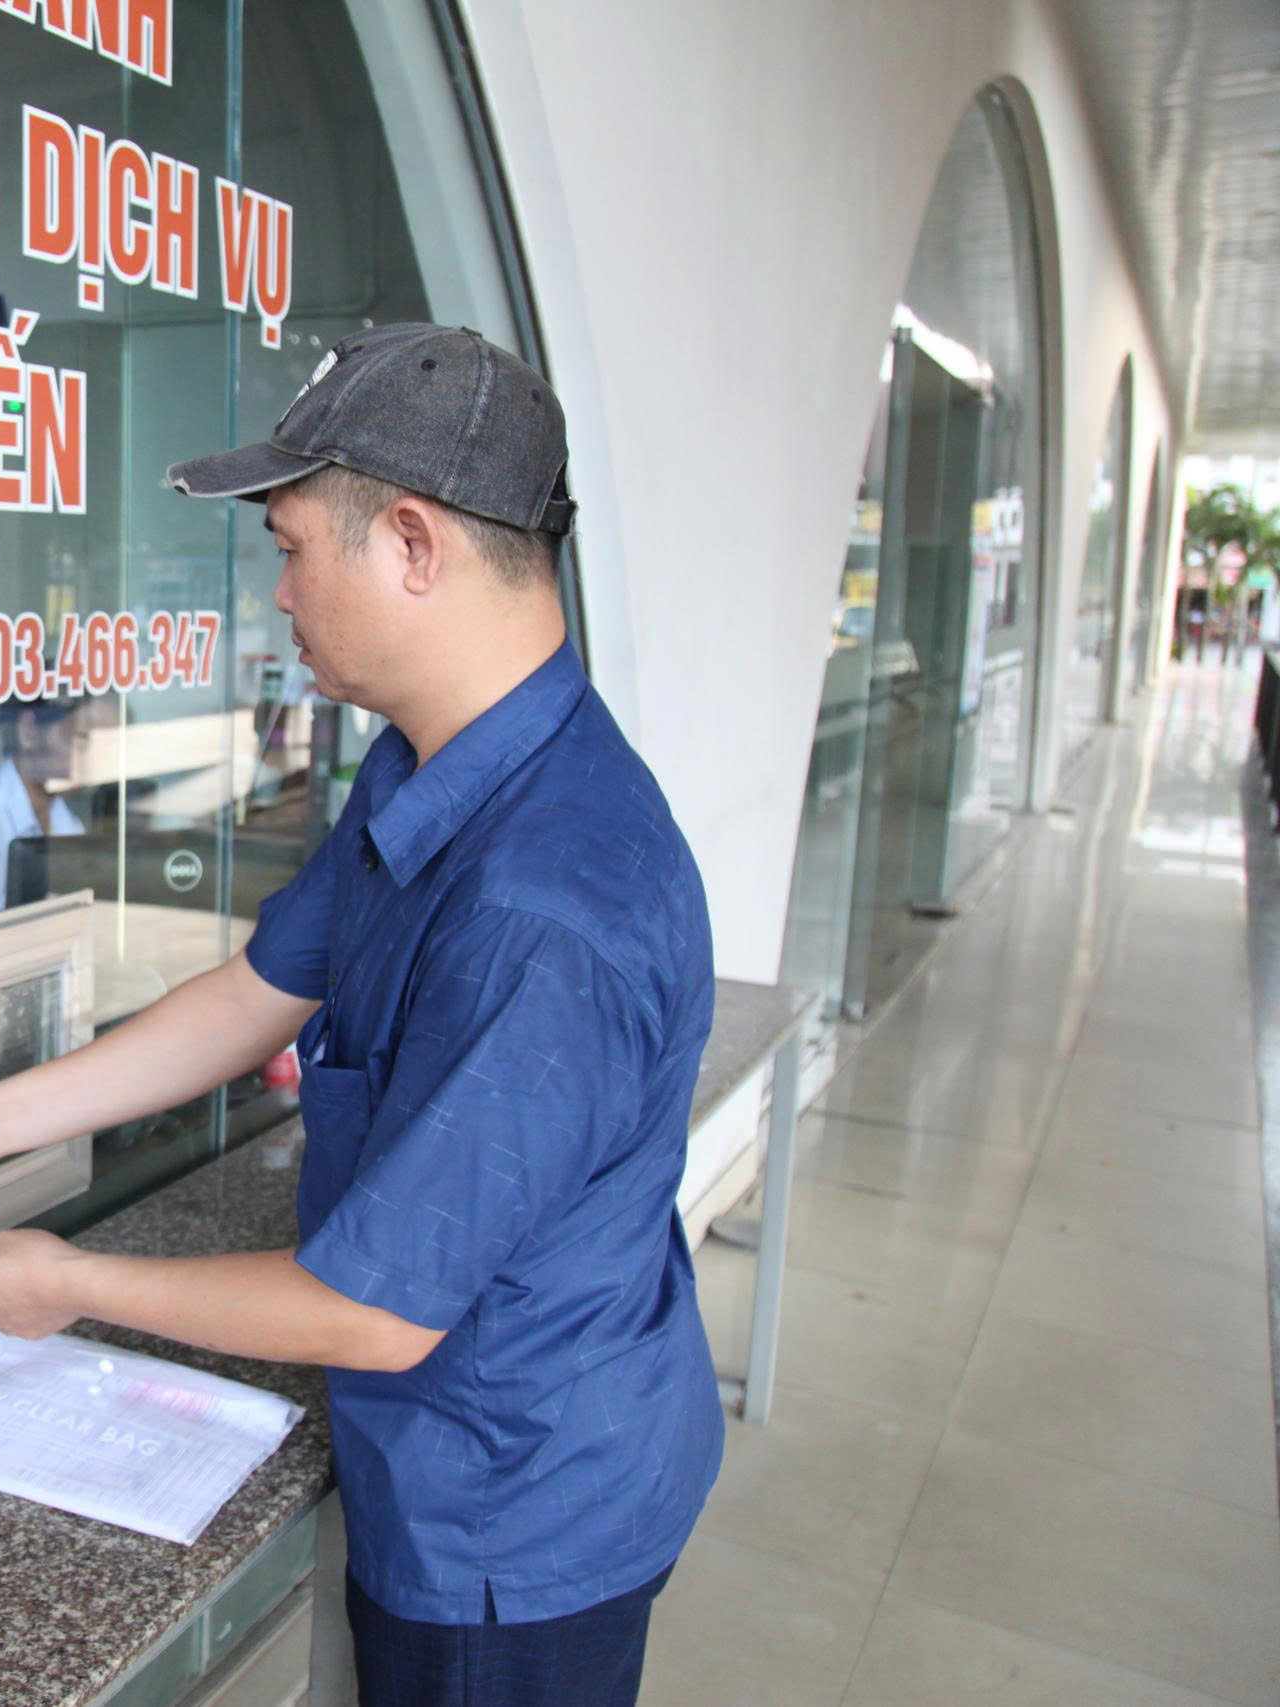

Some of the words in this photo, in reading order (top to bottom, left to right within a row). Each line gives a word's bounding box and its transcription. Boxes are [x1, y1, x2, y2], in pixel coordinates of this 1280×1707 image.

[22, 103, 199, 311] DỊCH
[215, 176, 293, 349] VỤ
[99, 1425, 162, 1457] BAG
